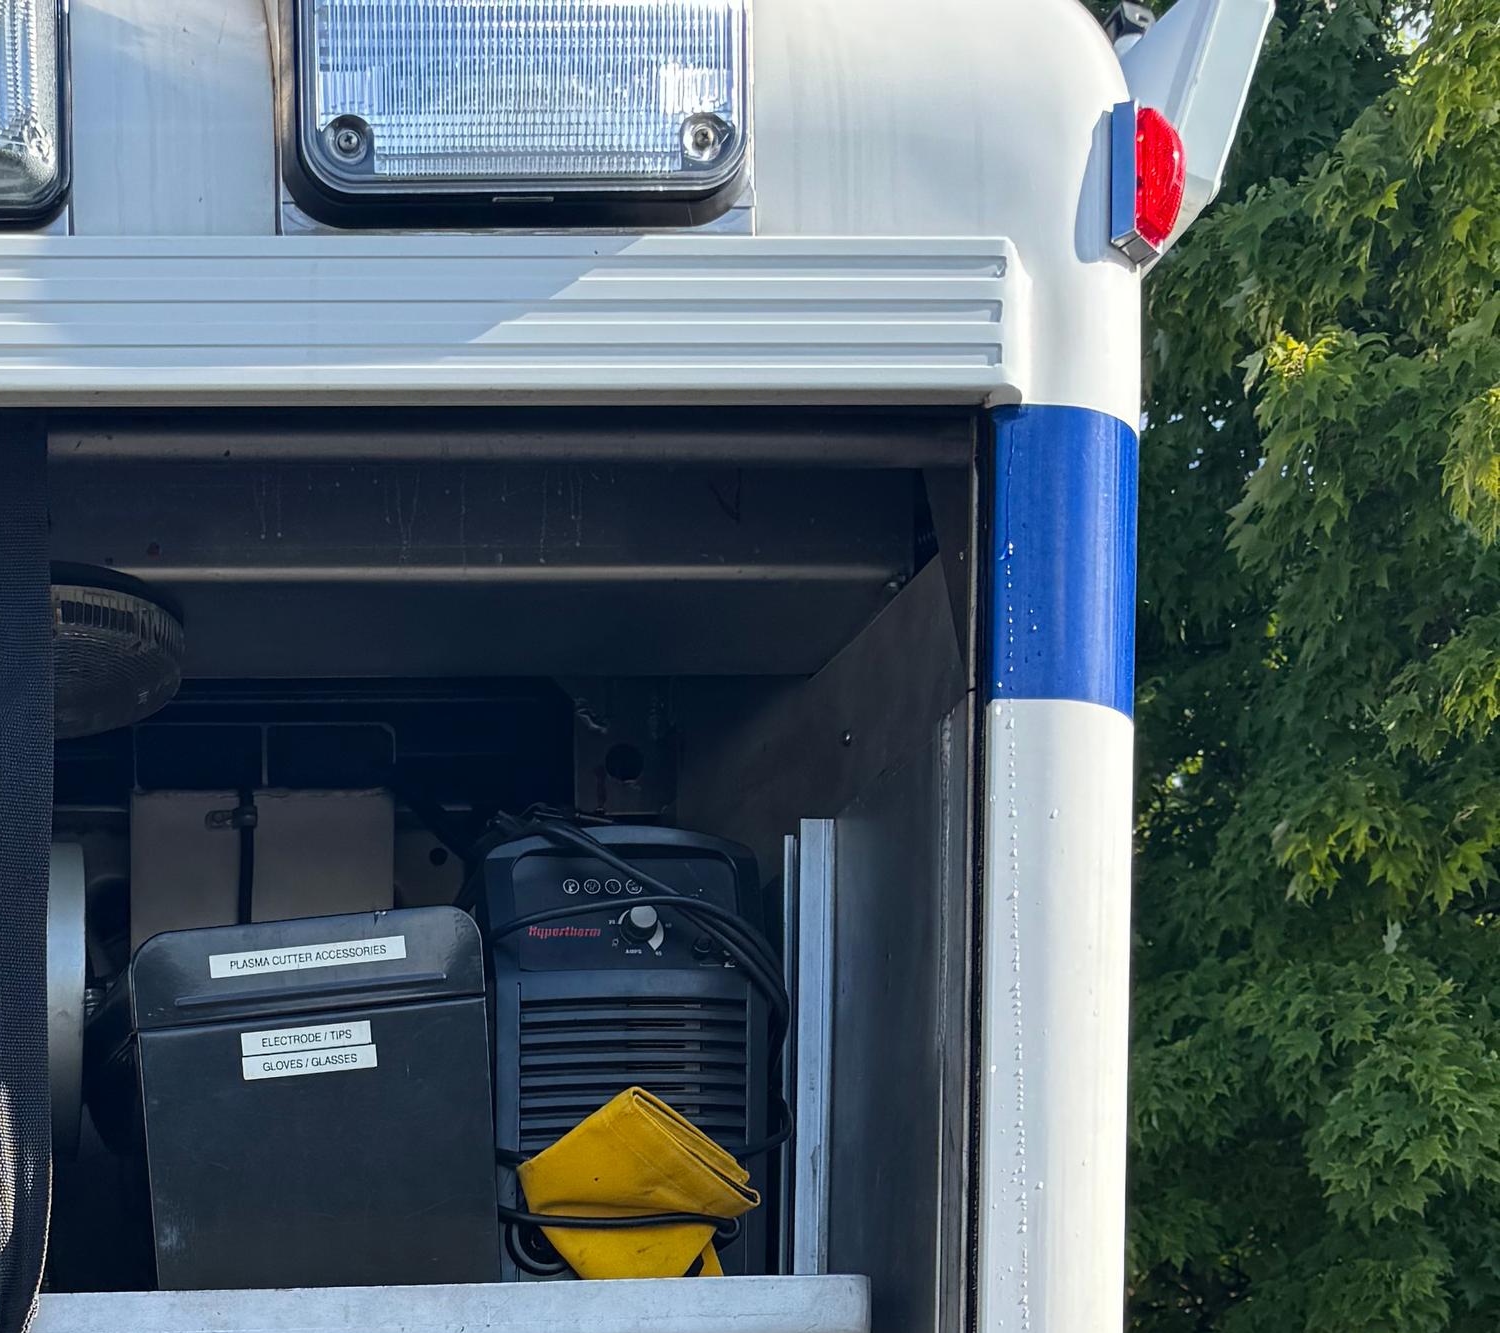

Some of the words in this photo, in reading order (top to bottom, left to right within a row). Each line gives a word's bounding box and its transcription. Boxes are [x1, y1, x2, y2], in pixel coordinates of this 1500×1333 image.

[229, 957, 270, 971] PLASMA
[272, 953, 313, 967] CUTTER
[314, 944, 387, 962] ACCESSORIES
[261, 1031, 321, 1048] ELECTRODE
[330, 1029, 353, 1041] TIPS
[262, 1058, 304, 1072] GLOVES
[311, 1053, 358, 1068] GLASSES
